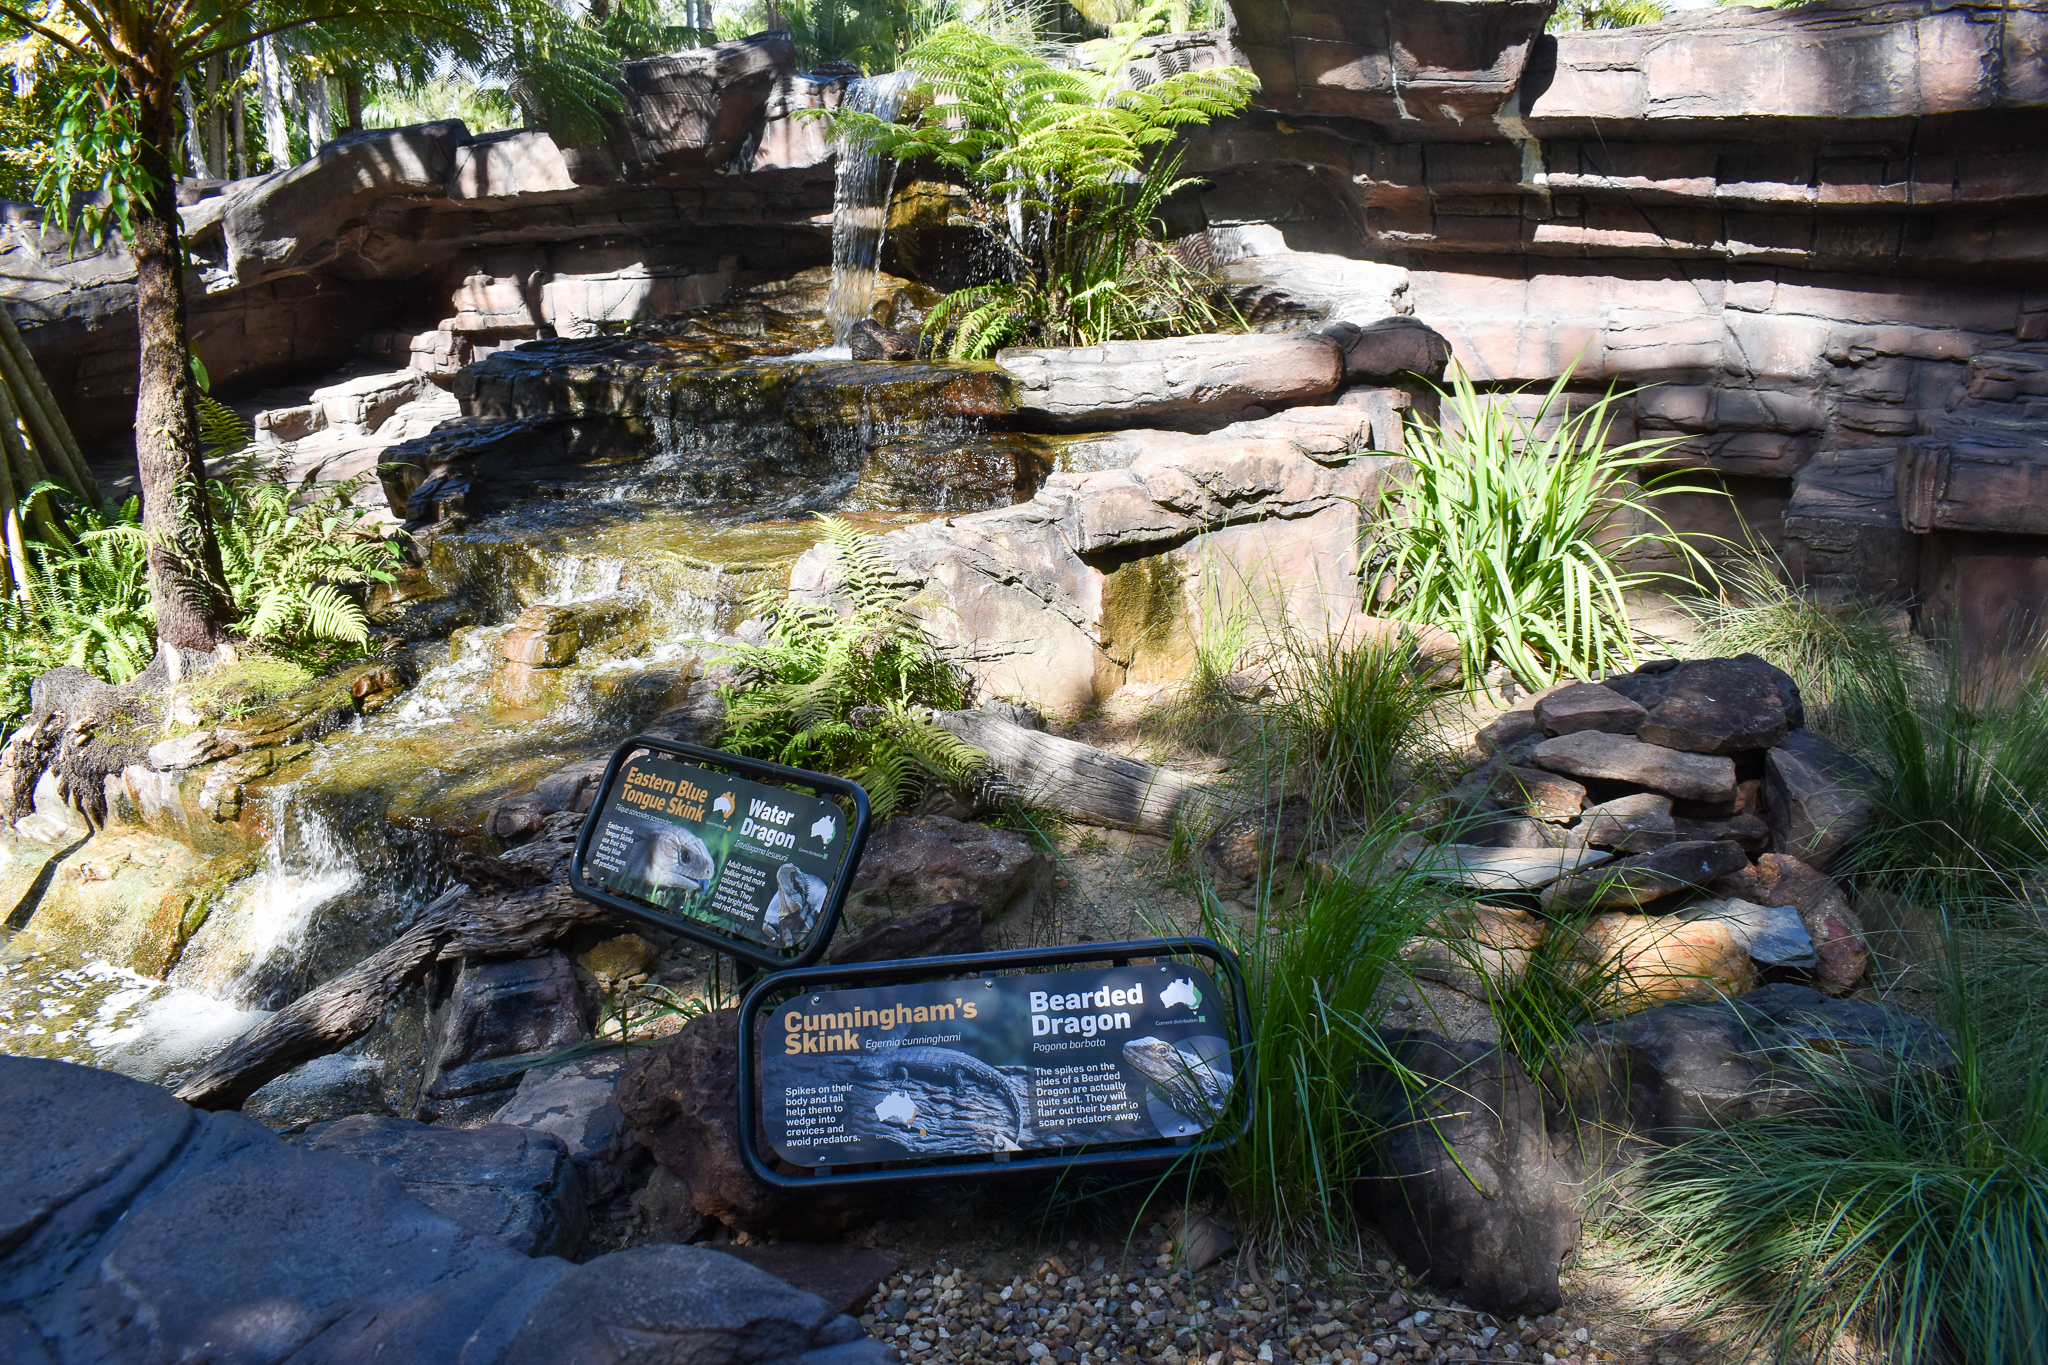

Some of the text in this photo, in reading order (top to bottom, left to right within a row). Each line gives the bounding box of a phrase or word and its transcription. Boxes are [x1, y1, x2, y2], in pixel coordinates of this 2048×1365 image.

[626, 767, 708, 803] Eastern Blue
[621, 784, 705, 822] Tongue Skink
[749, 798, 795, 826] Water
[608, 821, 634, 835] Eastern Blue
[740, 817, 796, 849] Dragon
[605, 829, 634, 843] Tongue Skinks
[598, 843, 621, 856] fleshy blue
[596, 851, 610, 862] tongue
[615, 858, 626, 866] warn
[599, 861, 620, 873] predators.
[727, 860, 742, 870] Adult
[742, 865, 757, 874] males
[721, 876, 755, 892] colourful than
[724, 868, 766, 886] bulkier and more
[717, 883, 753, 901] females. They
[715, 892, 760, 913] have bright yellow
[711, 900, 755, 921] and red markings.
[1029, 982, 1144, 1012] Bearded
[784, 998, 978, 1033] Cunningham's
[1173, 1017, 1198, 1025] distribution
[1031, 1011, 1131, 1037] Dragon
[784, 1029, 860, 1055] Skink
[865, 1032, 961, 1050] Egernia cunninghami
[1033, 1038, 1106, 1053] Pogona barbata
[1034, 1062, 1115, 1076] The spikes on the
[1035, 1077, 1060, 1086] sides
[1063, 1075, 1071, 1084] of
[1082, 1071, 1120, 1082] Bearded
[785, 1083, 853, 1098] Spikes on their
[1036, 1087, 1070, 1097] Dragon
[1090, 1082, 1126, 1092] actually
[785, 1093, 844, 1107] body and tail
[1037, 1092, 1127, 1108] quite soft. They will
[785, 1104, 843, 1117] help them to
[1037, 1101, 1138, 1117] flair out their beard to
[786, 1115, 836, 1128] wedge into
[1039, 1112, 1141, 1127] scare predators away.
[786, 1124, 844, 1137] crevices and
[786, 1134, 861, 1147] avoid predators.
